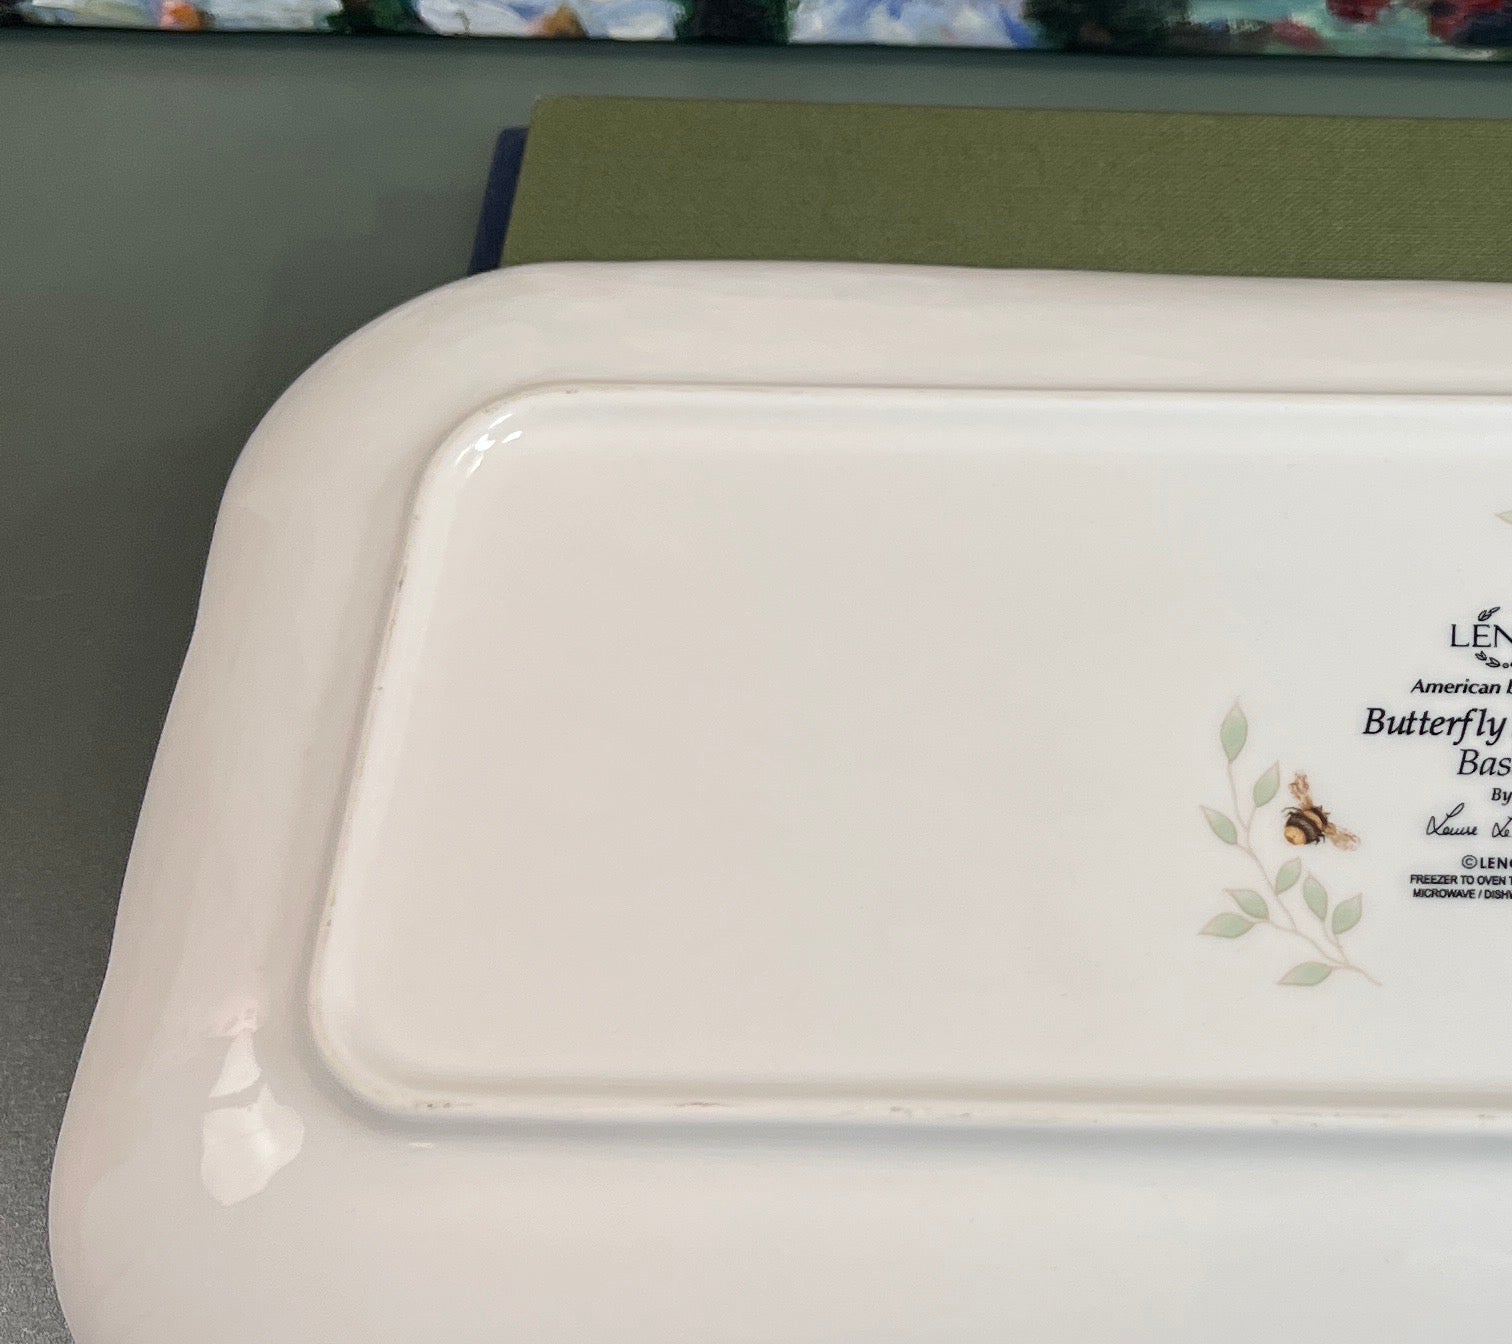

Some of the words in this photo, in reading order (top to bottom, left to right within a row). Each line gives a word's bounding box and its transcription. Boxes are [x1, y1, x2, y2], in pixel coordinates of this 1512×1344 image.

[1410, 679, 1501, 695] American
[1362, 707, 1507, 746] Butterfly
[1409, 874, 1458, 885] FREEZER
[1460, 874, 1475, 885] TO
[1477, 875, 1507, 886] OVEN
[1412, 887, 1477, 900] MICROWAVE
